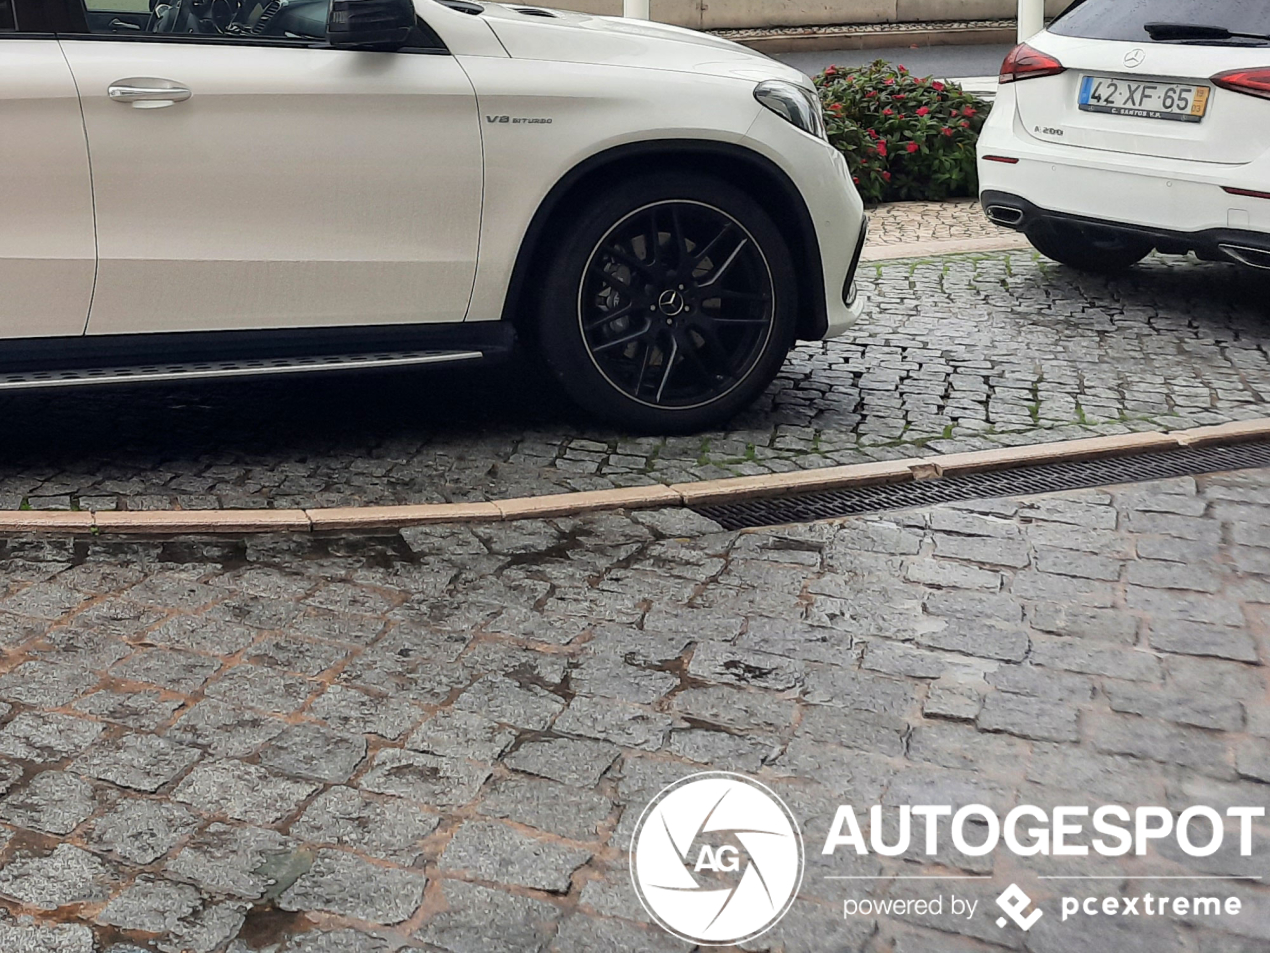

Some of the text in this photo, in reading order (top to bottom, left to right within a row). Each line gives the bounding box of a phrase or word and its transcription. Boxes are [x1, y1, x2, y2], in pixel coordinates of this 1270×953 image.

[1120, 109, 1147, 117] SANTOS
[1192, 104, 1201, 113] 03
[486, 115, 510, 124] V8
[1042, 126, 1064, 136] 200
